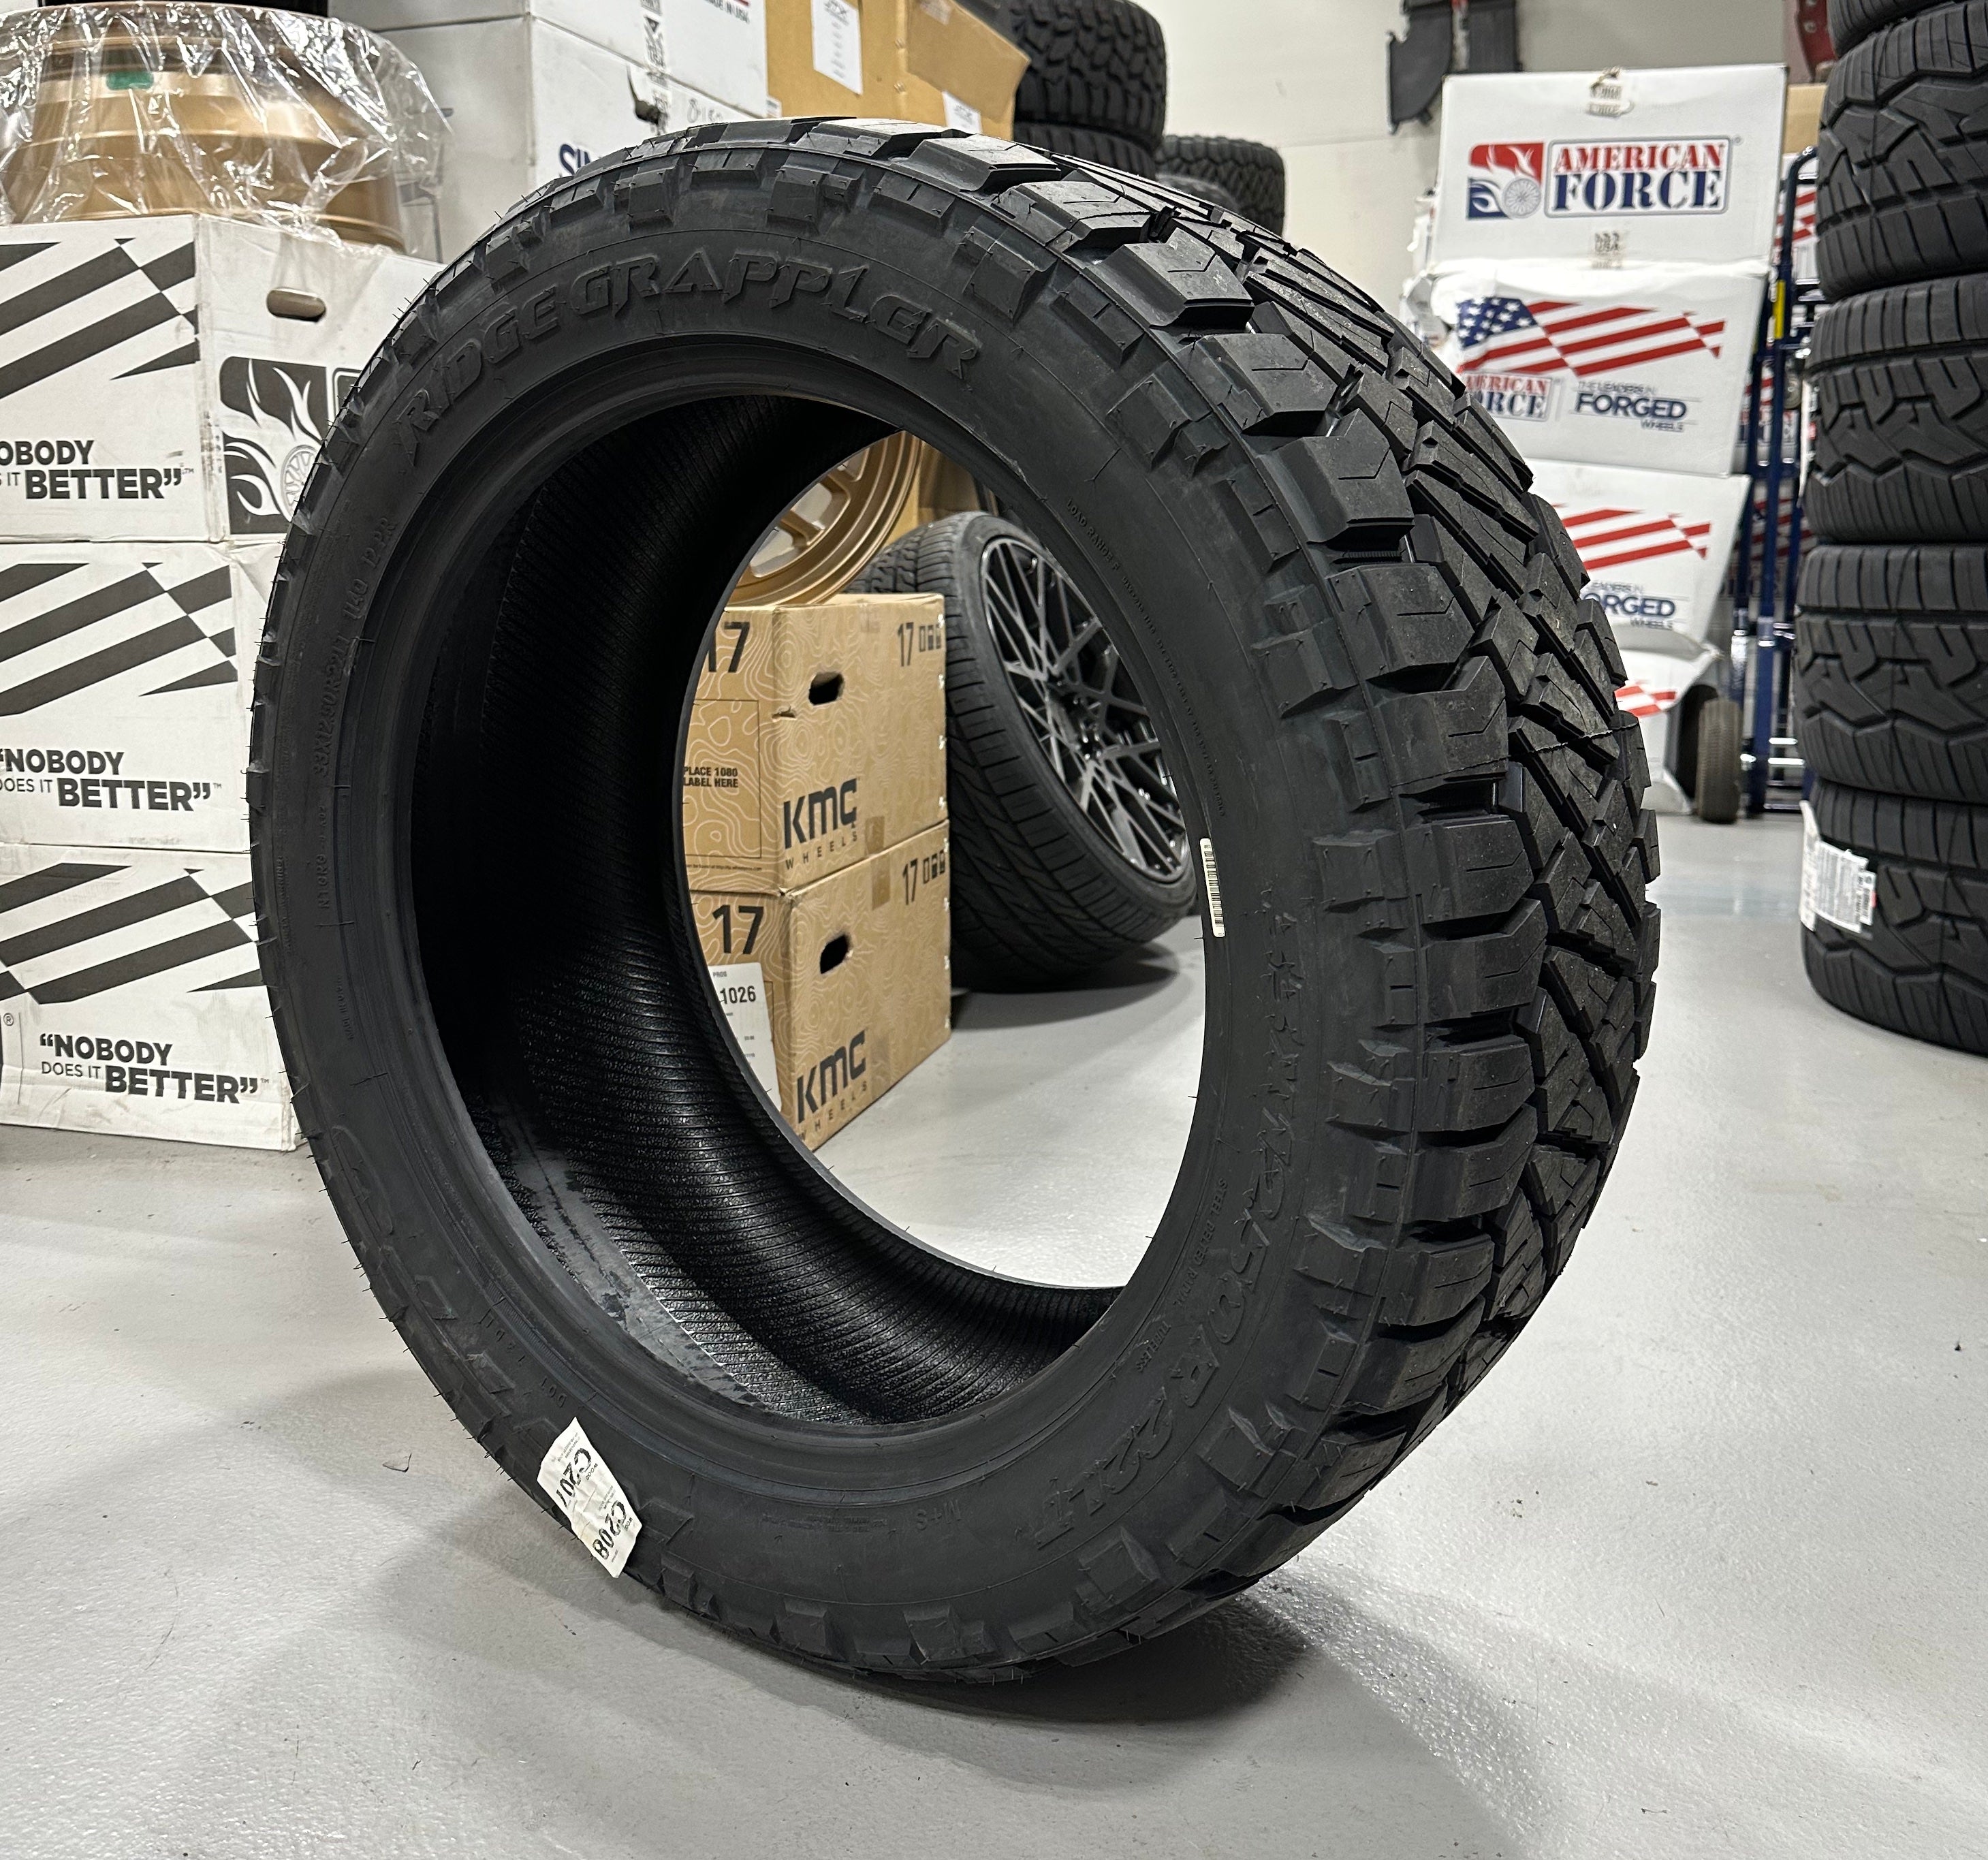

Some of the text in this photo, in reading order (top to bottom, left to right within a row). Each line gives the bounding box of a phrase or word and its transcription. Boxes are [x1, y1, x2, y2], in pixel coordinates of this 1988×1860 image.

[1555, 143, 1724, 172] AMERICAN
[1553, 170, 1720, 211] FORCE
[394, 284, 560, 467] RIDGE
[569, 247, 983, 380] GRAPPLER
[1575, 392, 1687, 421] FORGED
[7, 472, 21, 486] IT
[898, 622, 914, 667] 17
[40, 780, 52, 793] IT
[683, 777, 738, 788] LABEL HERE
[714, 768, 738, 777] 1080
[785, 831, 857, 870] WHEELS
[902, 858, 917, 905] 17
[712, 905, 765, 956] 17
[720, 986, 756, 1004] 1026
[41, 1061, 82, 1077] DOES
[88, 1065, 100, 1079] IT
[1212, 1177, 1227, 1219] STEEL
[556, 1447, 592, 1507] C207
[592, 1500, 627, 1560] C208
[915, 1498, 962, 1532] M+S
